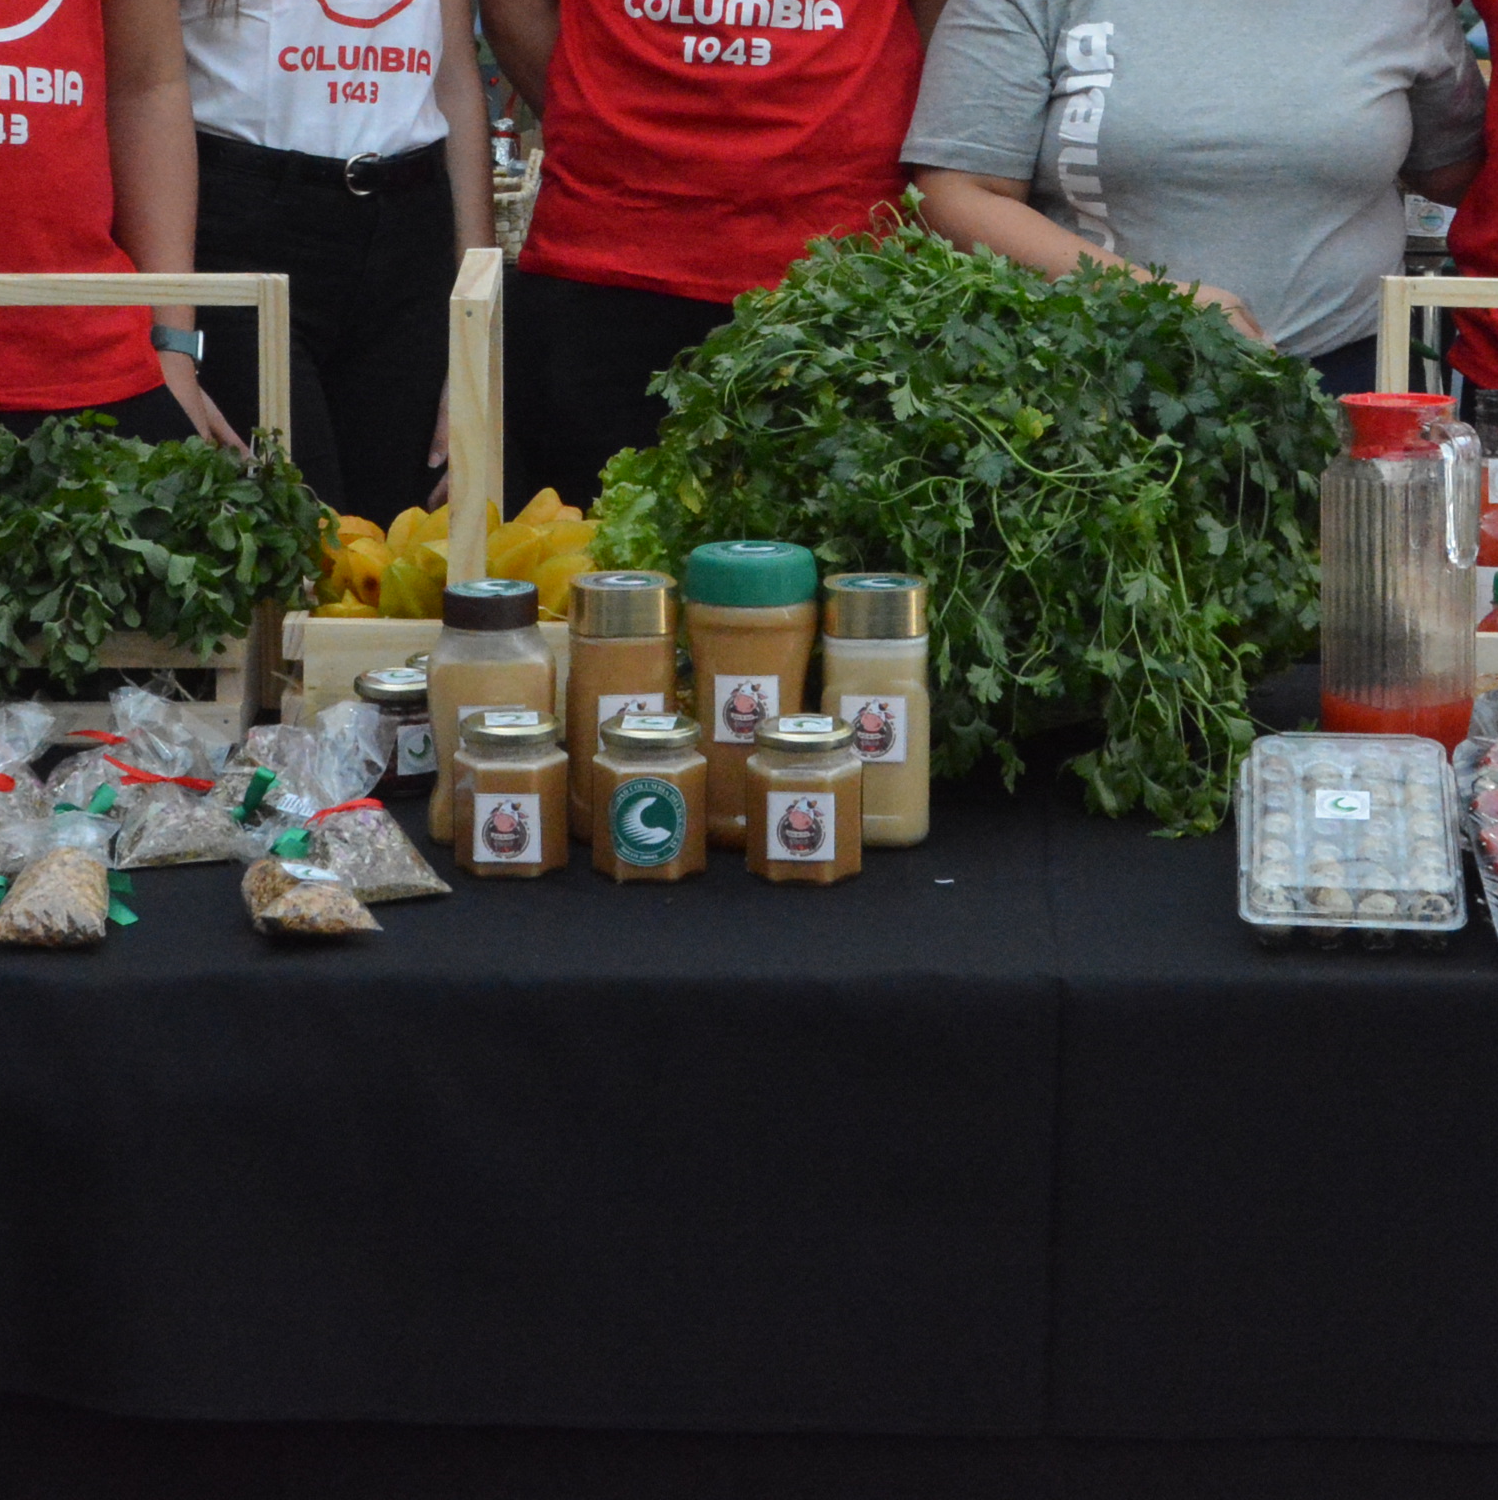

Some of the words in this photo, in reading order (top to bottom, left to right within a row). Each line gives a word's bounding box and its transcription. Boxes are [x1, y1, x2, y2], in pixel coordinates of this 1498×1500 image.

[277, 45, 432, 76] COLUMBIA
[682, 35, 772, 66] 1943
[327, 80, 380, 104] 1943
